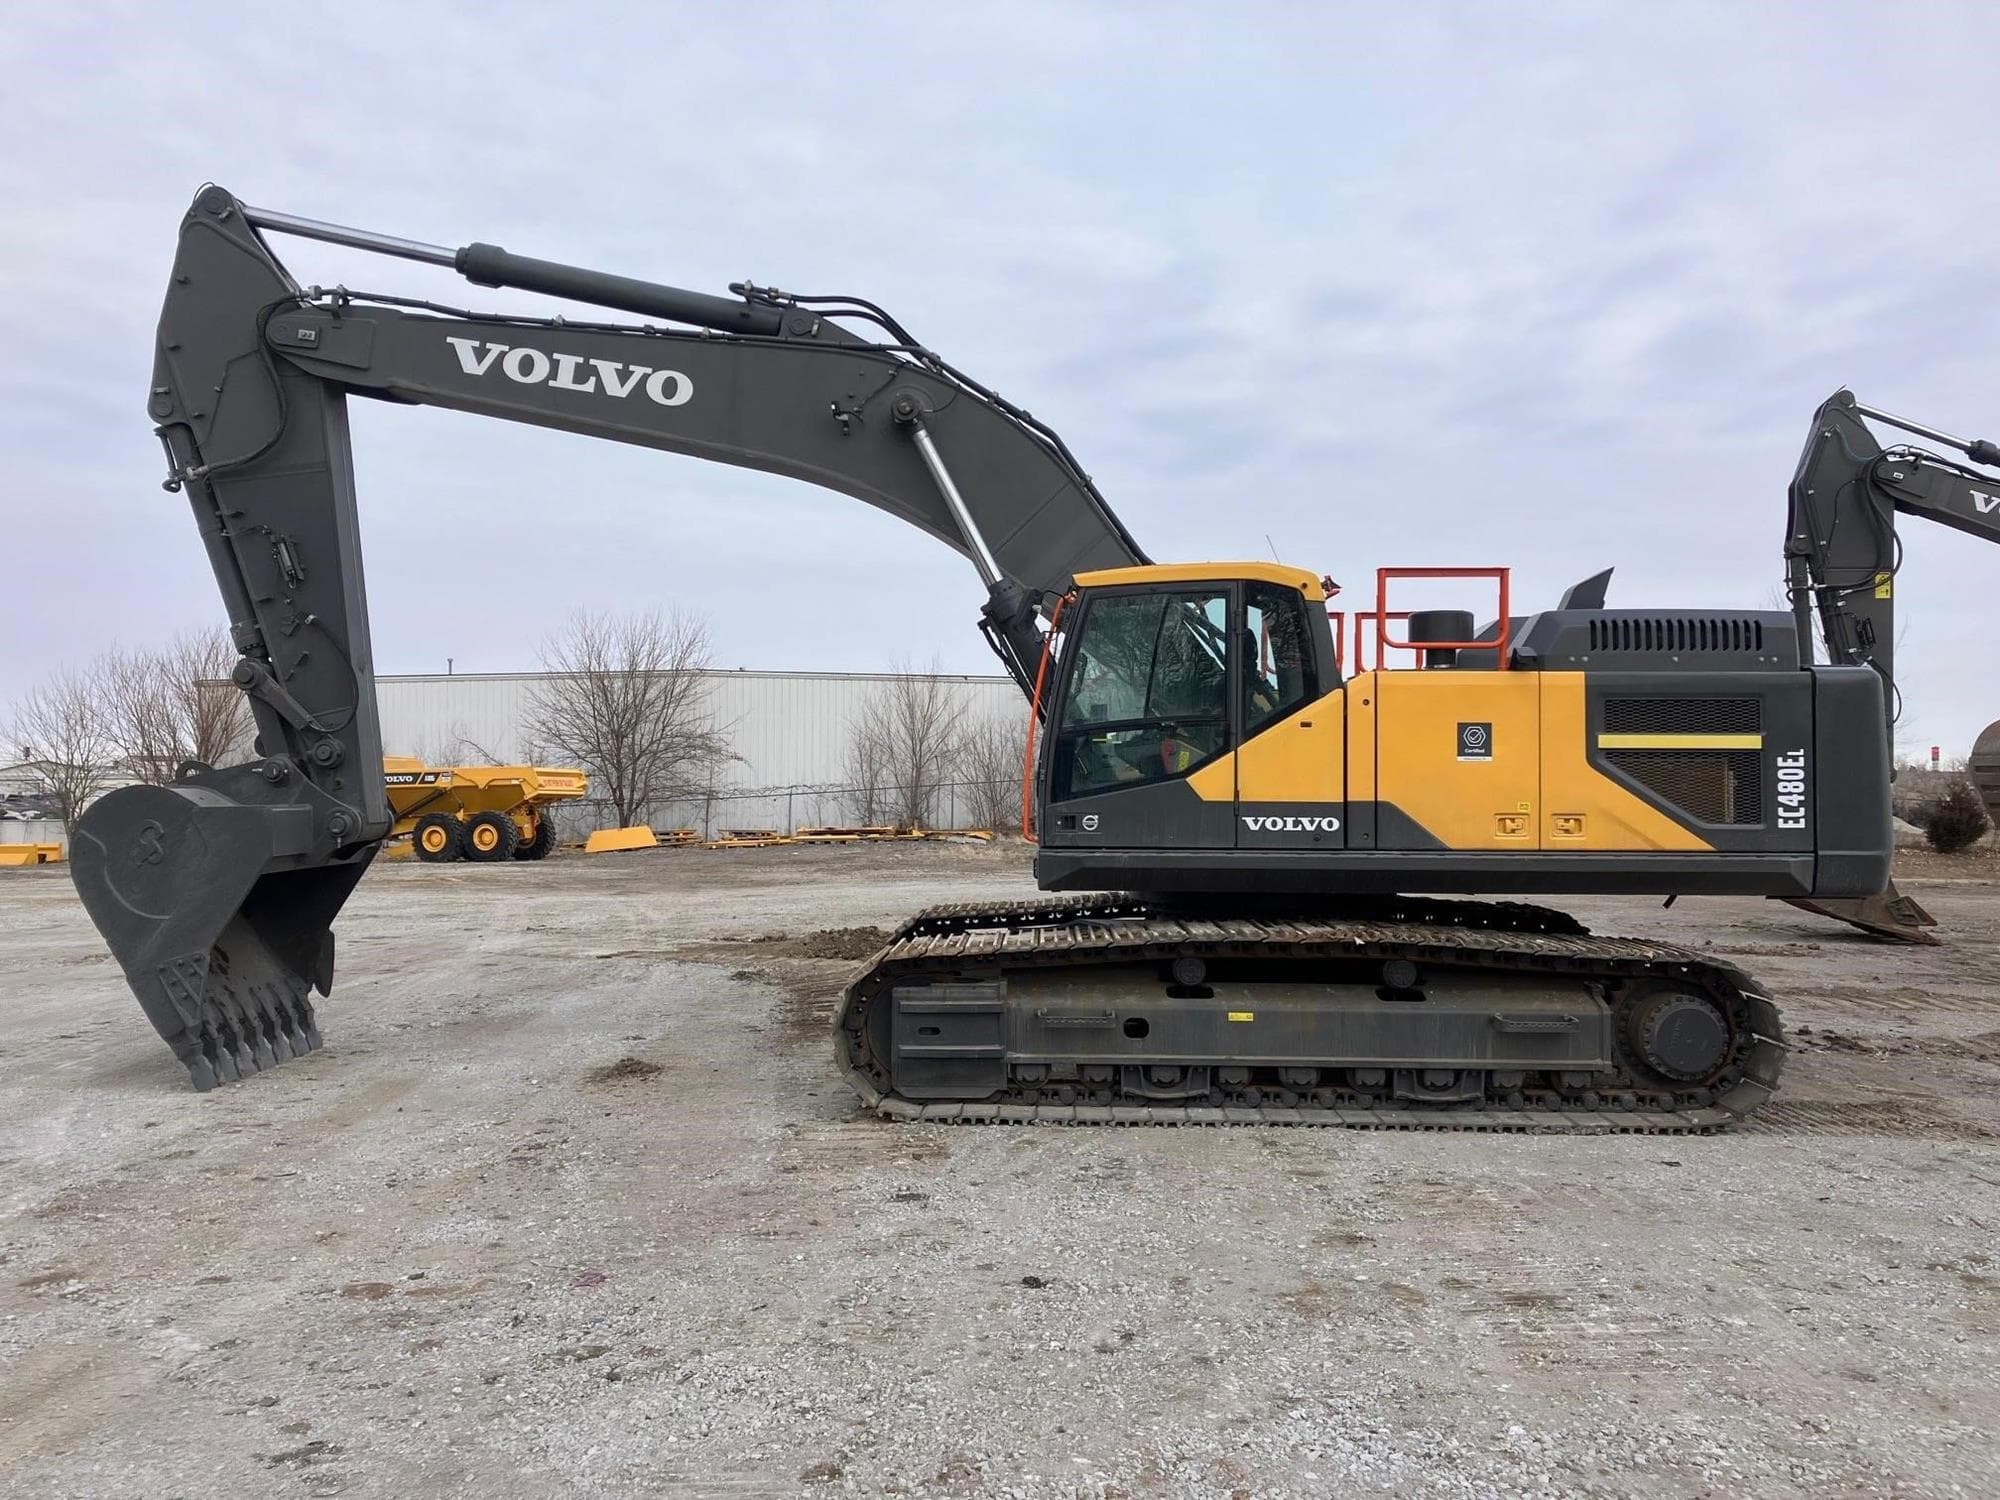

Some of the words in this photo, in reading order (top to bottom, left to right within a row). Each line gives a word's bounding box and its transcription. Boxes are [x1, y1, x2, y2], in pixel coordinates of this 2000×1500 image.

[446, 336, 694, 407] VOLVO
[1969, 489, 2000, 514] V
[1777, 748, 1805, 828] EC480EL
[1241, 816, 1340, 831] VOLVO
